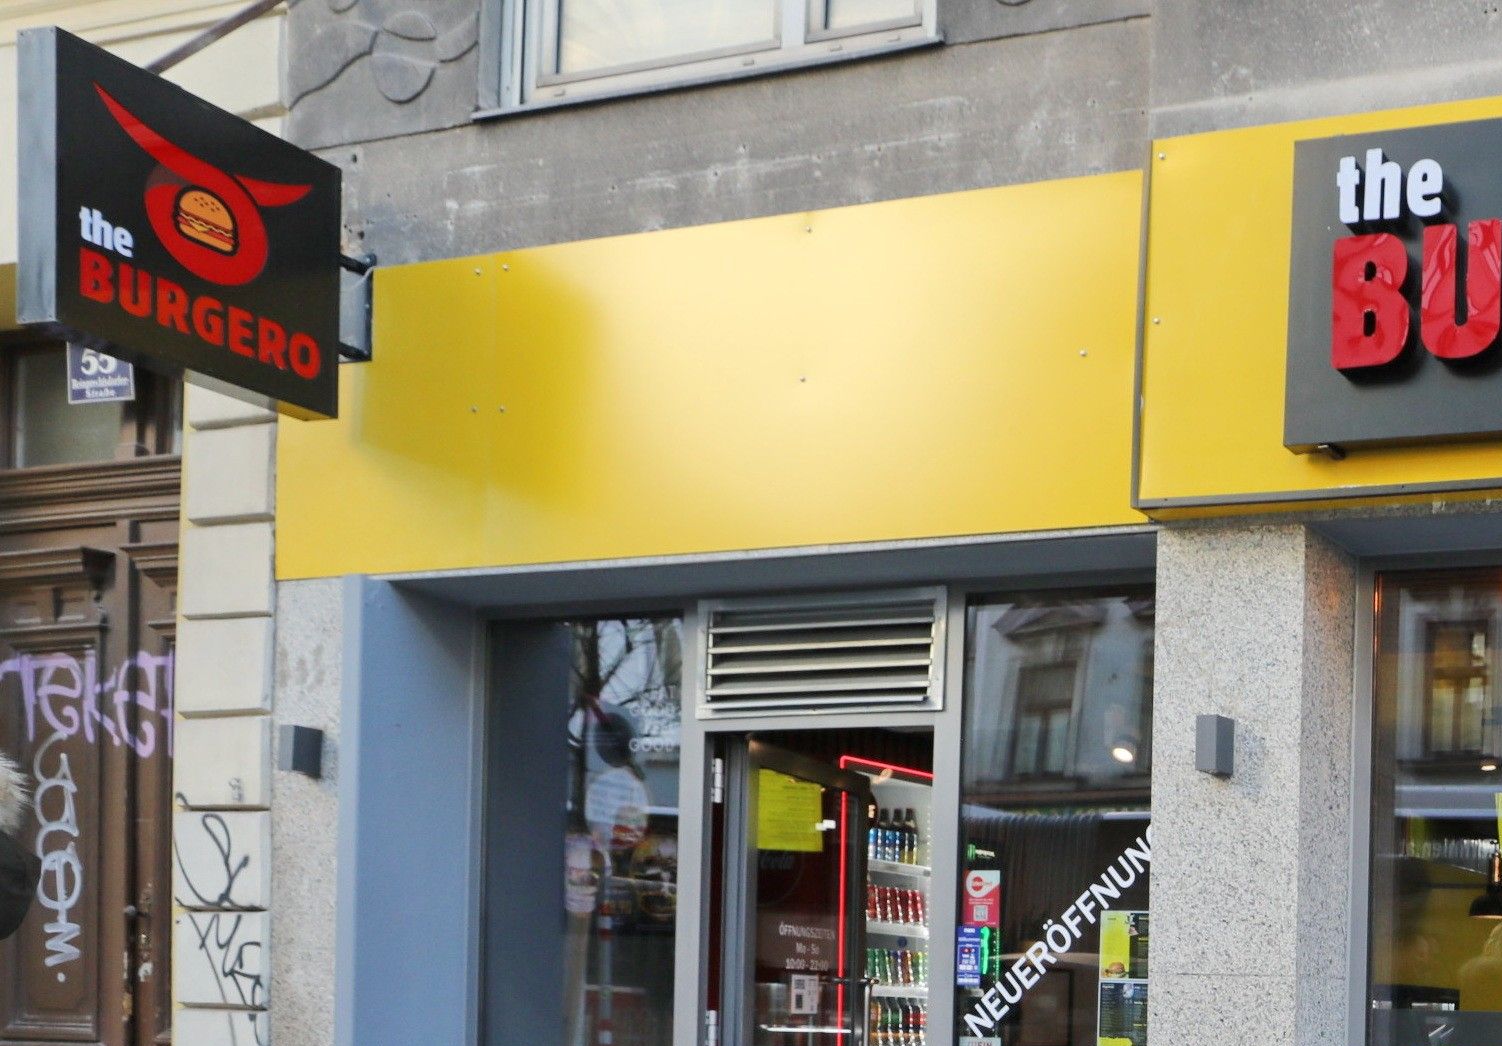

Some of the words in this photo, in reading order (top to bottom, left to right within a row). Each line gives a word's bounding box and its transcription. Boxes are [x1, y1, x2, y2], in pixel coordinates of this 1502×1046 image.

[79, 205, 135, 259] the
[1336, 147, 1444, 224] the
[79, 246, 322, 381] BURGERO
[963, 824, 1151, 1039] NEUERÖFFNUN
